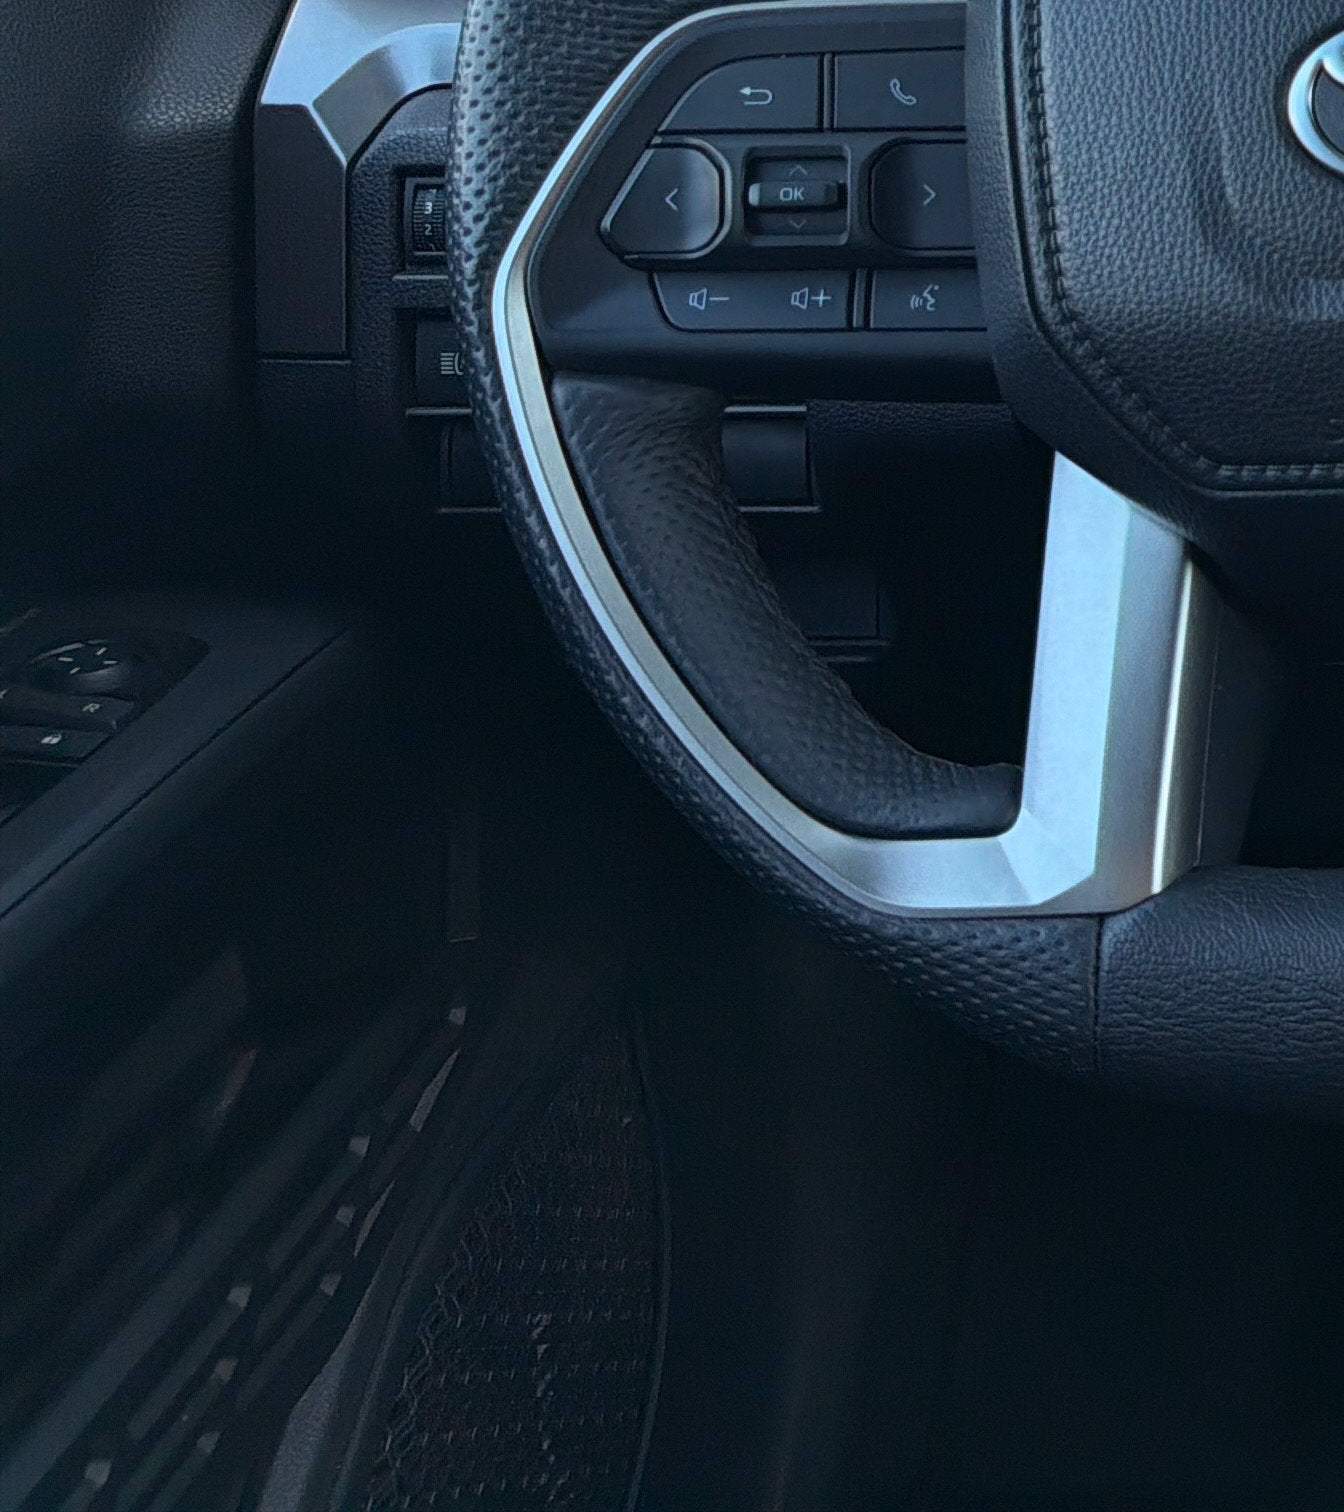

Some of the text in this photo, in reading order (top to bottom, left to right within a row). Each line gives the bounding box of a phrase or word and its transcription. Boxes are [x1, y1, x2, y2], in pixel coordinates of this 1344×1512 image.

[779, 187, 805, 202] OK
[423, 201, 434, 215] 3
[424, 223, 433, 236] 2
